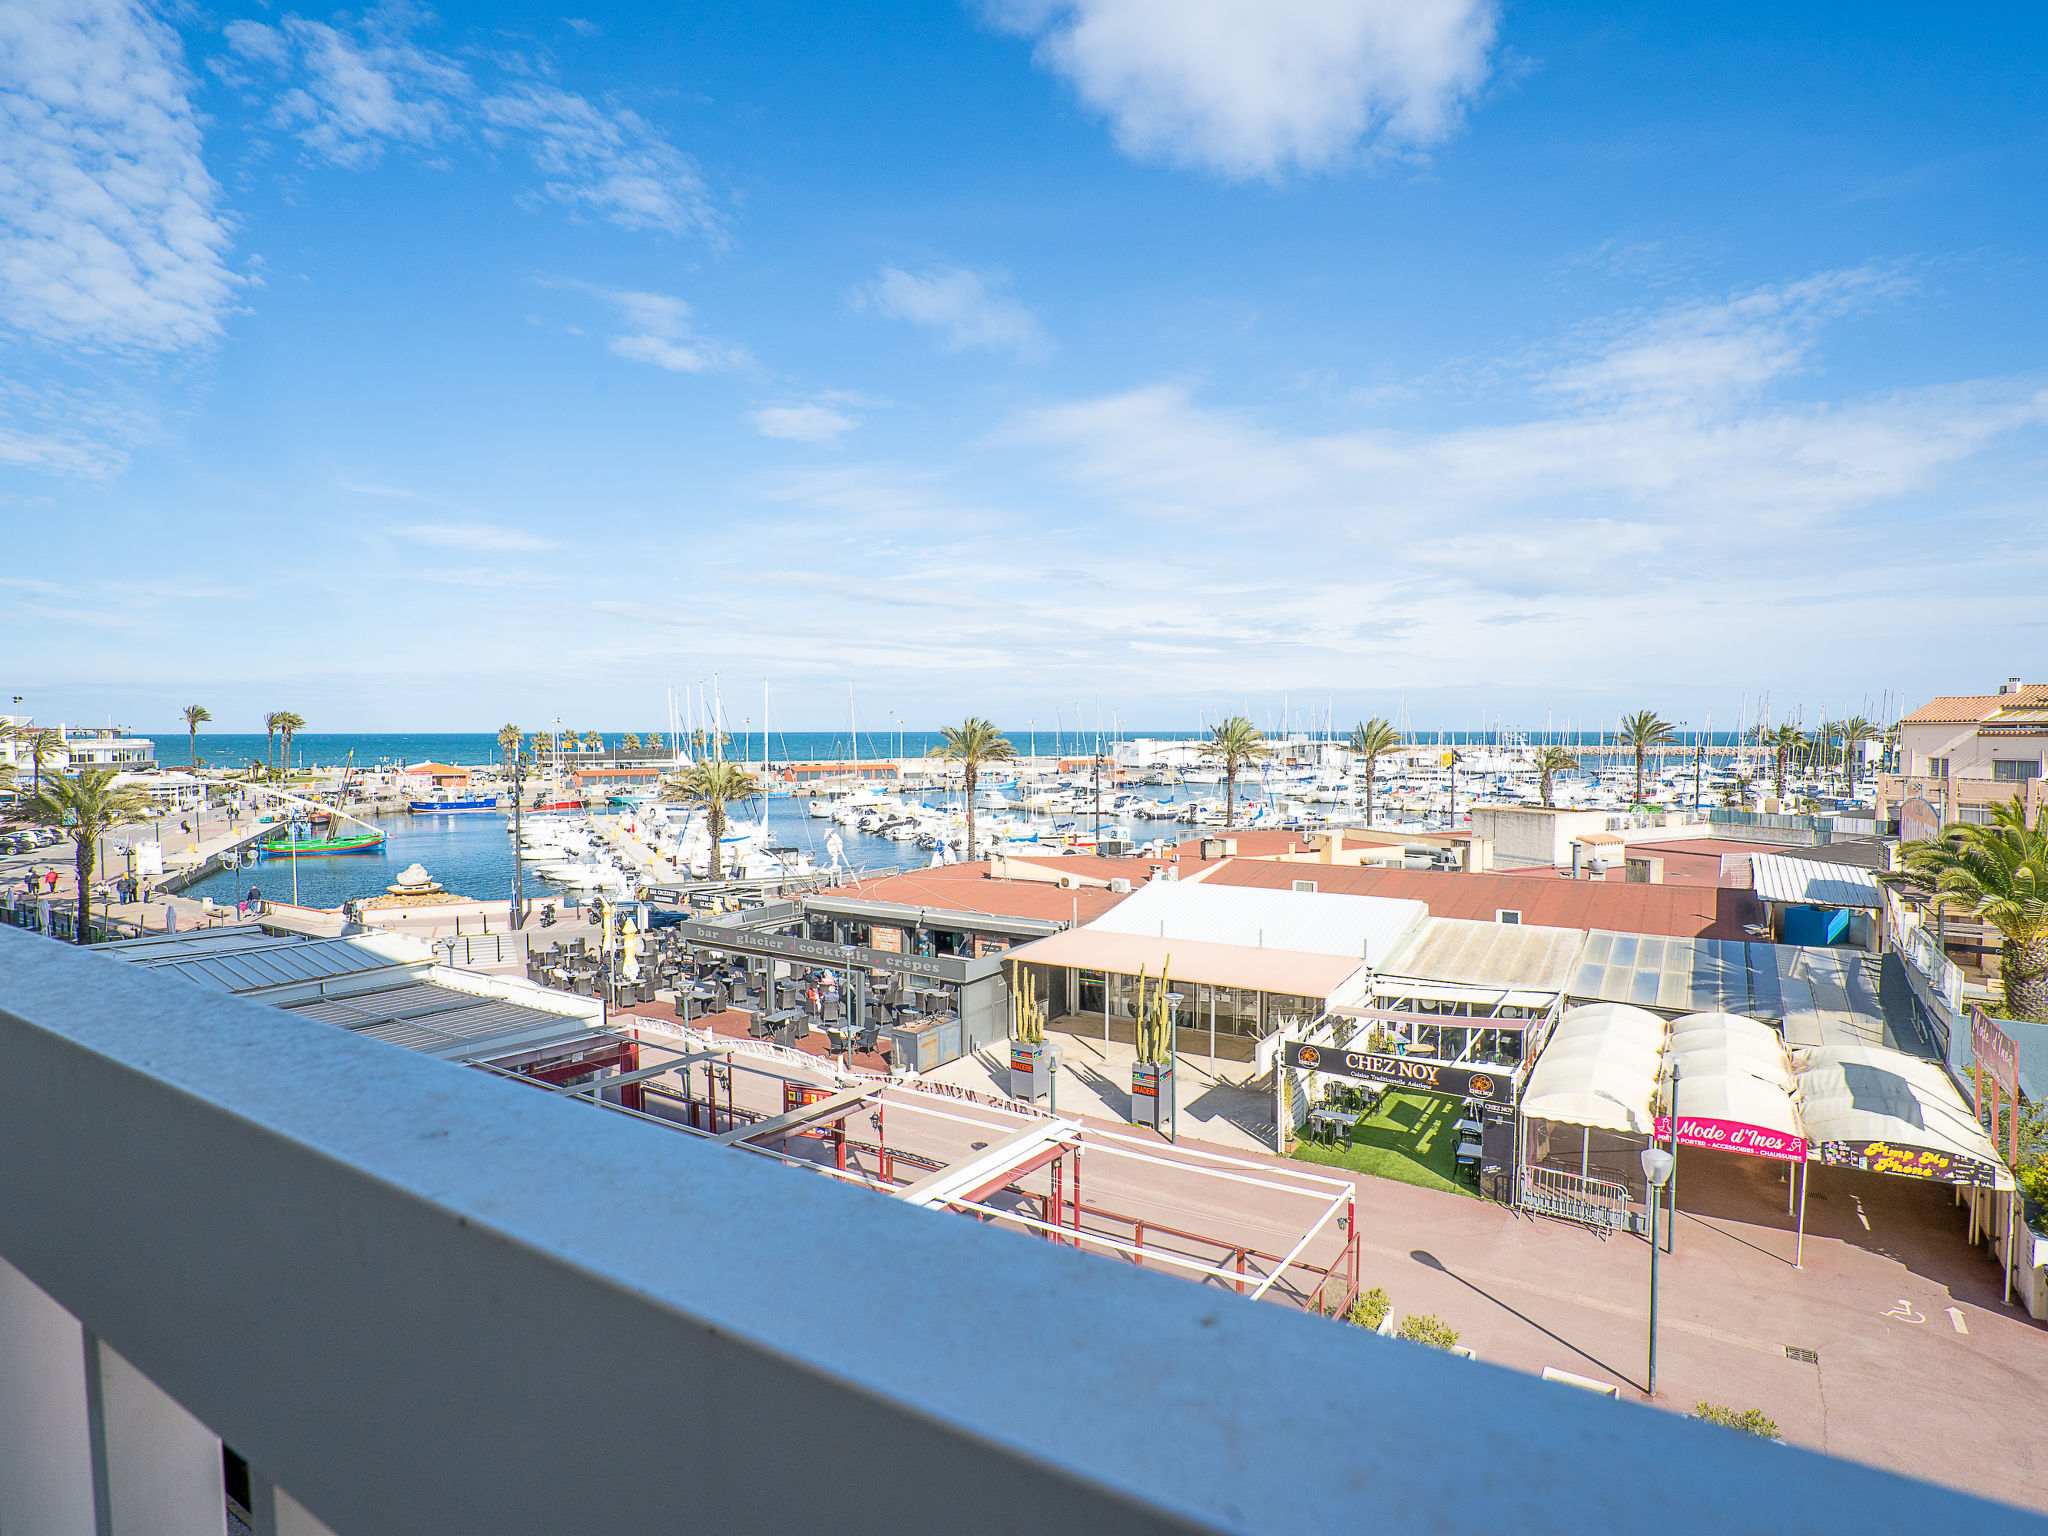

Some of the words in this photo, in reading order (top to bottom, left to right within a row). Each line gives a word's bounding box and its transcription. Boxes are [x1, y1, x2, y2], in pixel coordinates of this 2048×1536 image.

[697, 927, 719, 940] bar
[736, 932, 784, 950] glacier
[885, 957, 940, 973] crêpes
[1346, 1053, 1396, 1075] CHEZ
[1398, 1061, 1440, 1082] NOY
[1132, 1084, 1159, 1097] BRADERIE
[1350, 1071, 1370, 1079] Cuisine
[1407, 1081, 1432, 1091] Asiatique
[1676, 1121, 1727, 1140] Mode
[1730, 1129, 1785, 1149] d'Ines
[1681, 1138, 1706, 1147] PORTER
[1712, 1143, 1754, 1153] ACCESSOIRES
[1760, 1150, 1802, 1161] CHAUSSURES
[1863, 1142, 1915, 1162] Pimp
[1919, 1151, 1949, 1168] My
[1873, 1157, 1933, 1177] Phone
